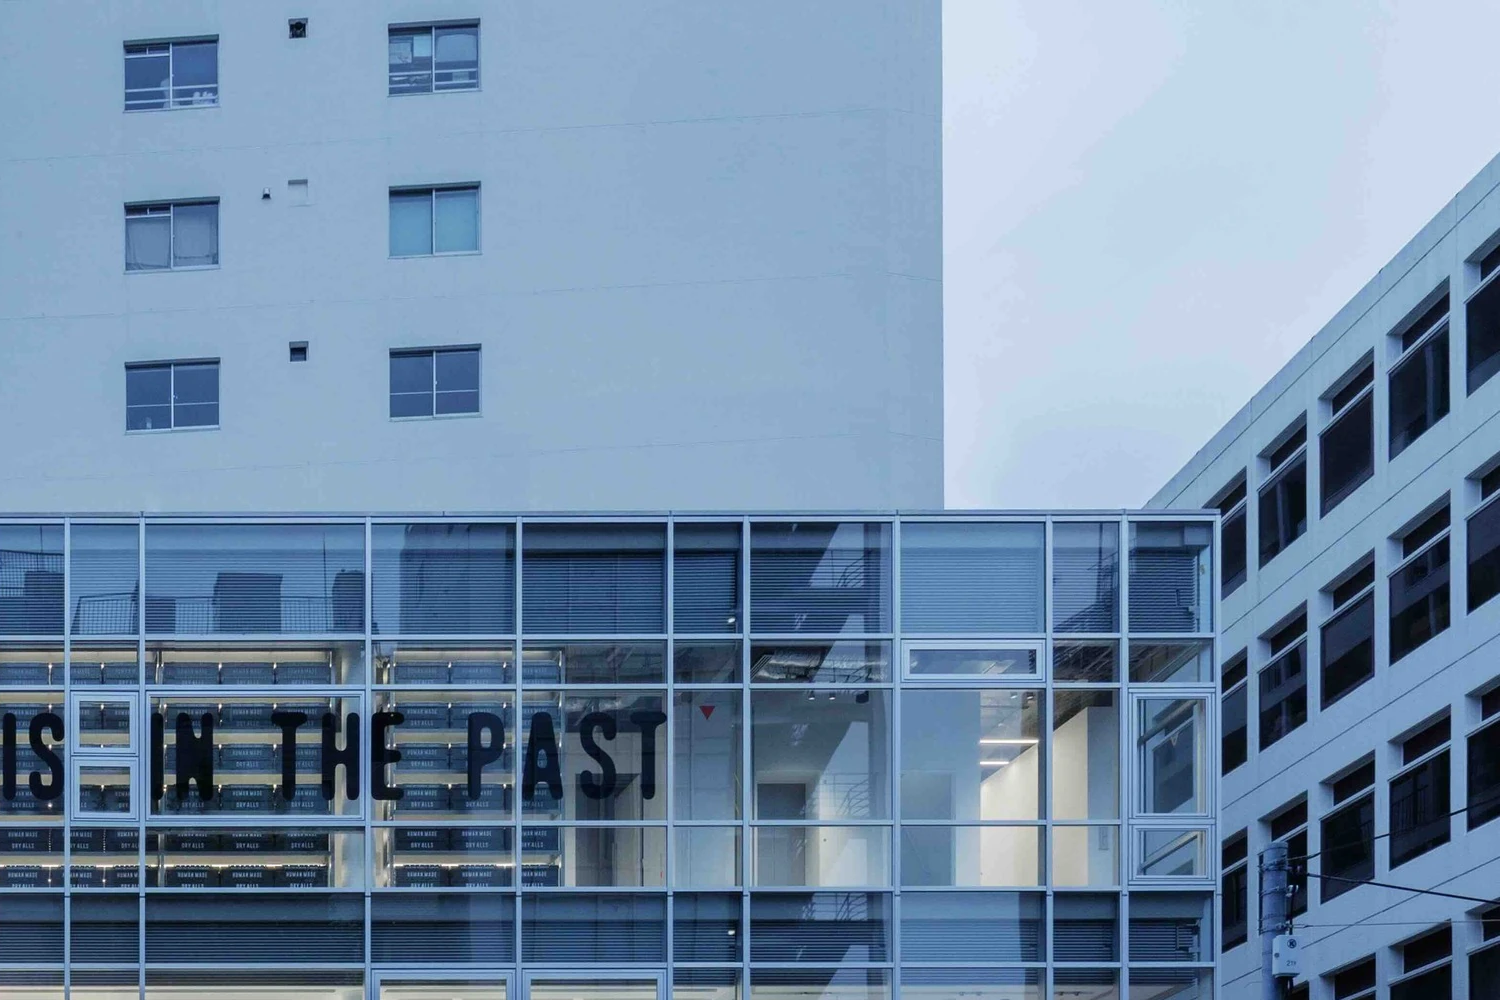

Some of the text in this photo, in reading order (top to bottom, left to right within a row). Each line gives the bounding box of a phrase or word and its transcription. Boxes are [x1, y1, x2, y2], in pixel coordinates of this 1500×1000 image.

[2, 711, 64, 802] IS
[151, 711, 214, 802] IN
[271, 711, 404, 802] THE
[467, 711, 667, 802] PAST
